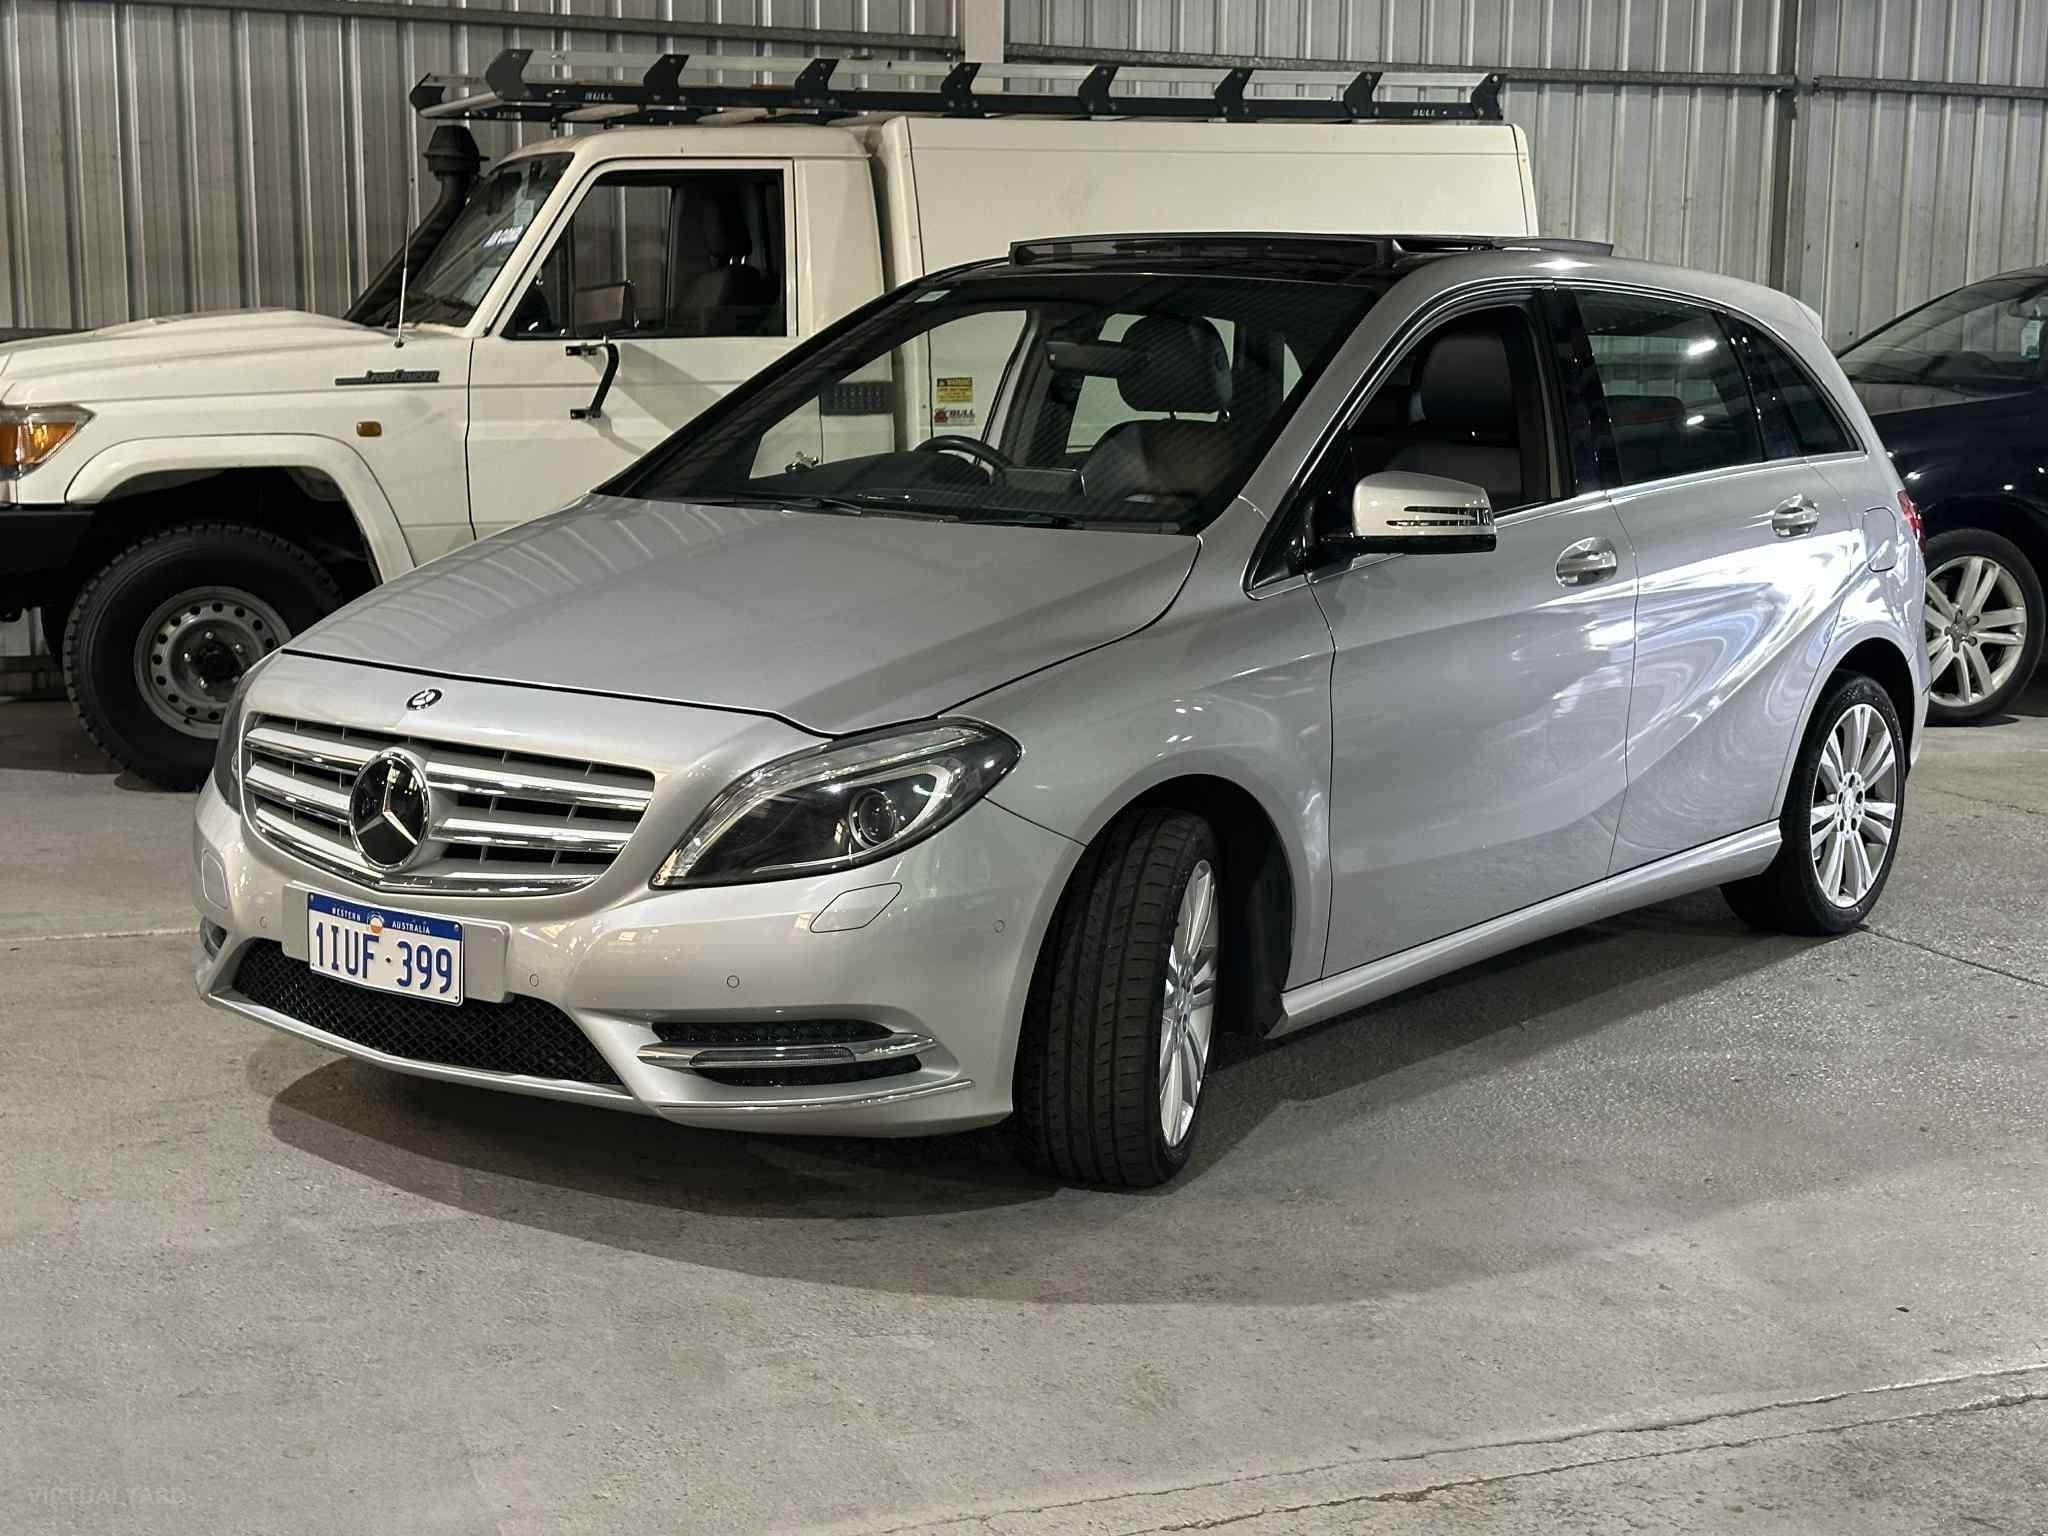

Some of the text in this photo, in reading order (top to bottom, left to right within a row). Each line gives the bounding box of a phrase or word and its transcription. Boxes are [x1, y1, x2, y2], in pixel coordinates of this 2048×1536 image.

[331, 906, 430, 934] WESTERN AUSTRALIA
[316, 921, 453, 994] 1IUF 399
